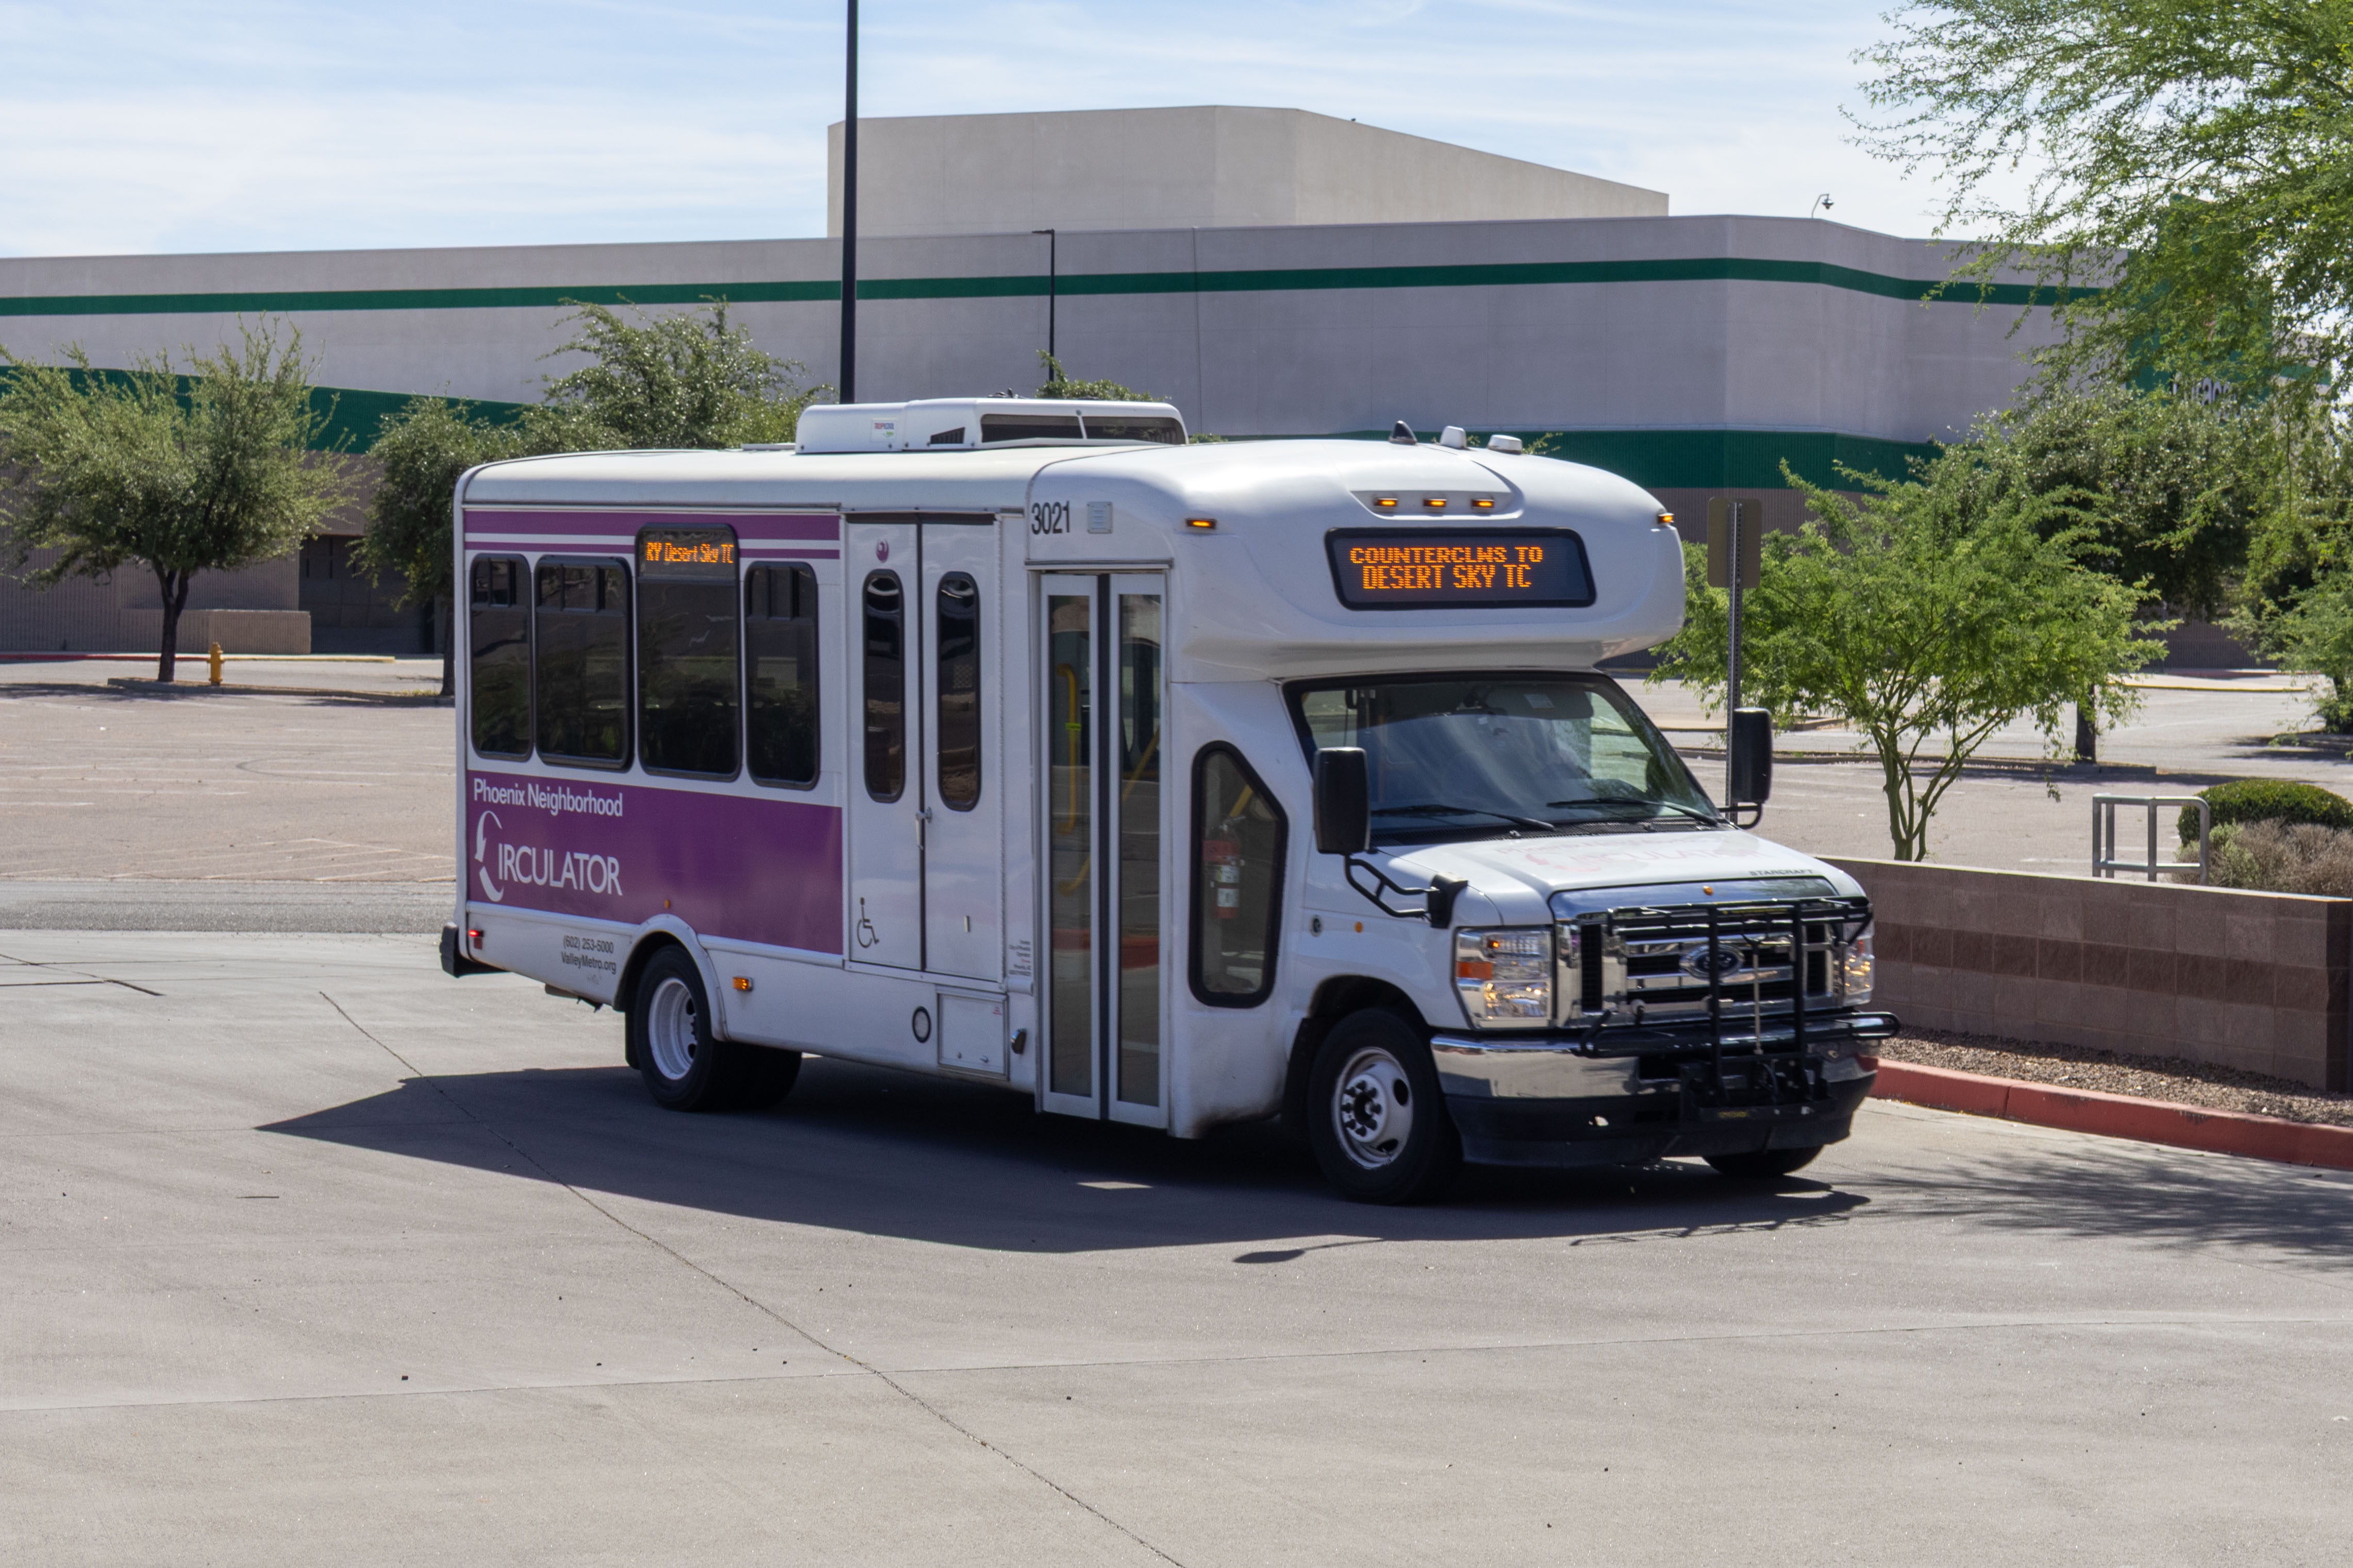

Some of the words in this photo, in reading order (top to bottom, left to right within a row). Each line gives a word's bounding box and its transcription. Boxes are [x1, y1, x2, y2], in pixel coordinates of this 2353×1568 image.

[1031, 501, 1070, 535] 3021
[664, 542, 698, 563] Desert
[700, 543, 719, 563] Sky
[721, 544, 735, 564] TC
[1349, 547, 1507, 564] COUNTERCLWS
[1514, 547, 1544, 563] TO
[1362, 565, 1445, 589] DESERT
[1453, 565, 1496, 588] SKY
[1503, 564, 1532, 588] TC
[473, 778, 526, 806] Phoenix
[527, 783, 623, 817] Neighborhood
[563, 935, 580, 951] (602)
[582, 938, 614, 954] 253-5000
[561, 951, 616, 974] ValleyMetro.org
